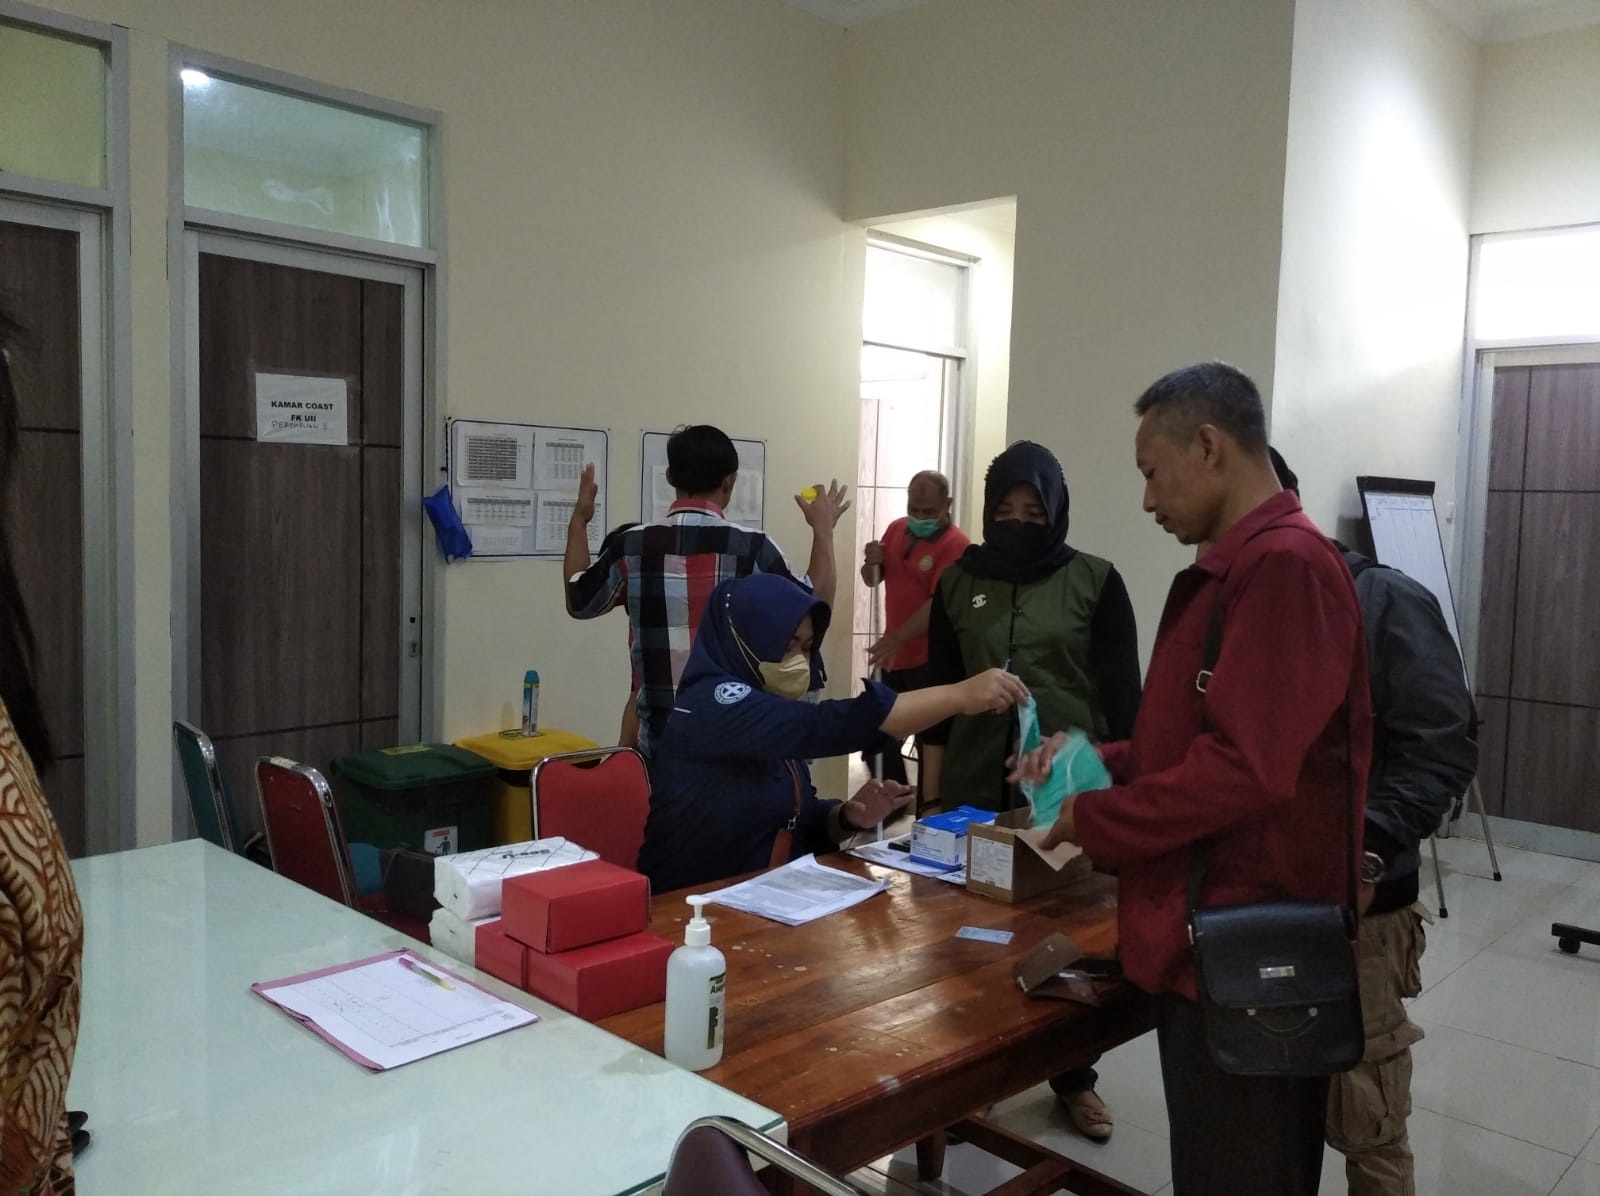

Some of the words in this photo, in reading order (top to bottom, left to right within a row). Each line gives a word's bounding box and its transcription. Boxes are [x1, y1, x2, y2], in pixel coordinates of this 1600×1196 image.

[271, 400, 303, 409] KAMAR
[305, 402, 334, 410] COAST
[290, 414, 302, 422] FK
